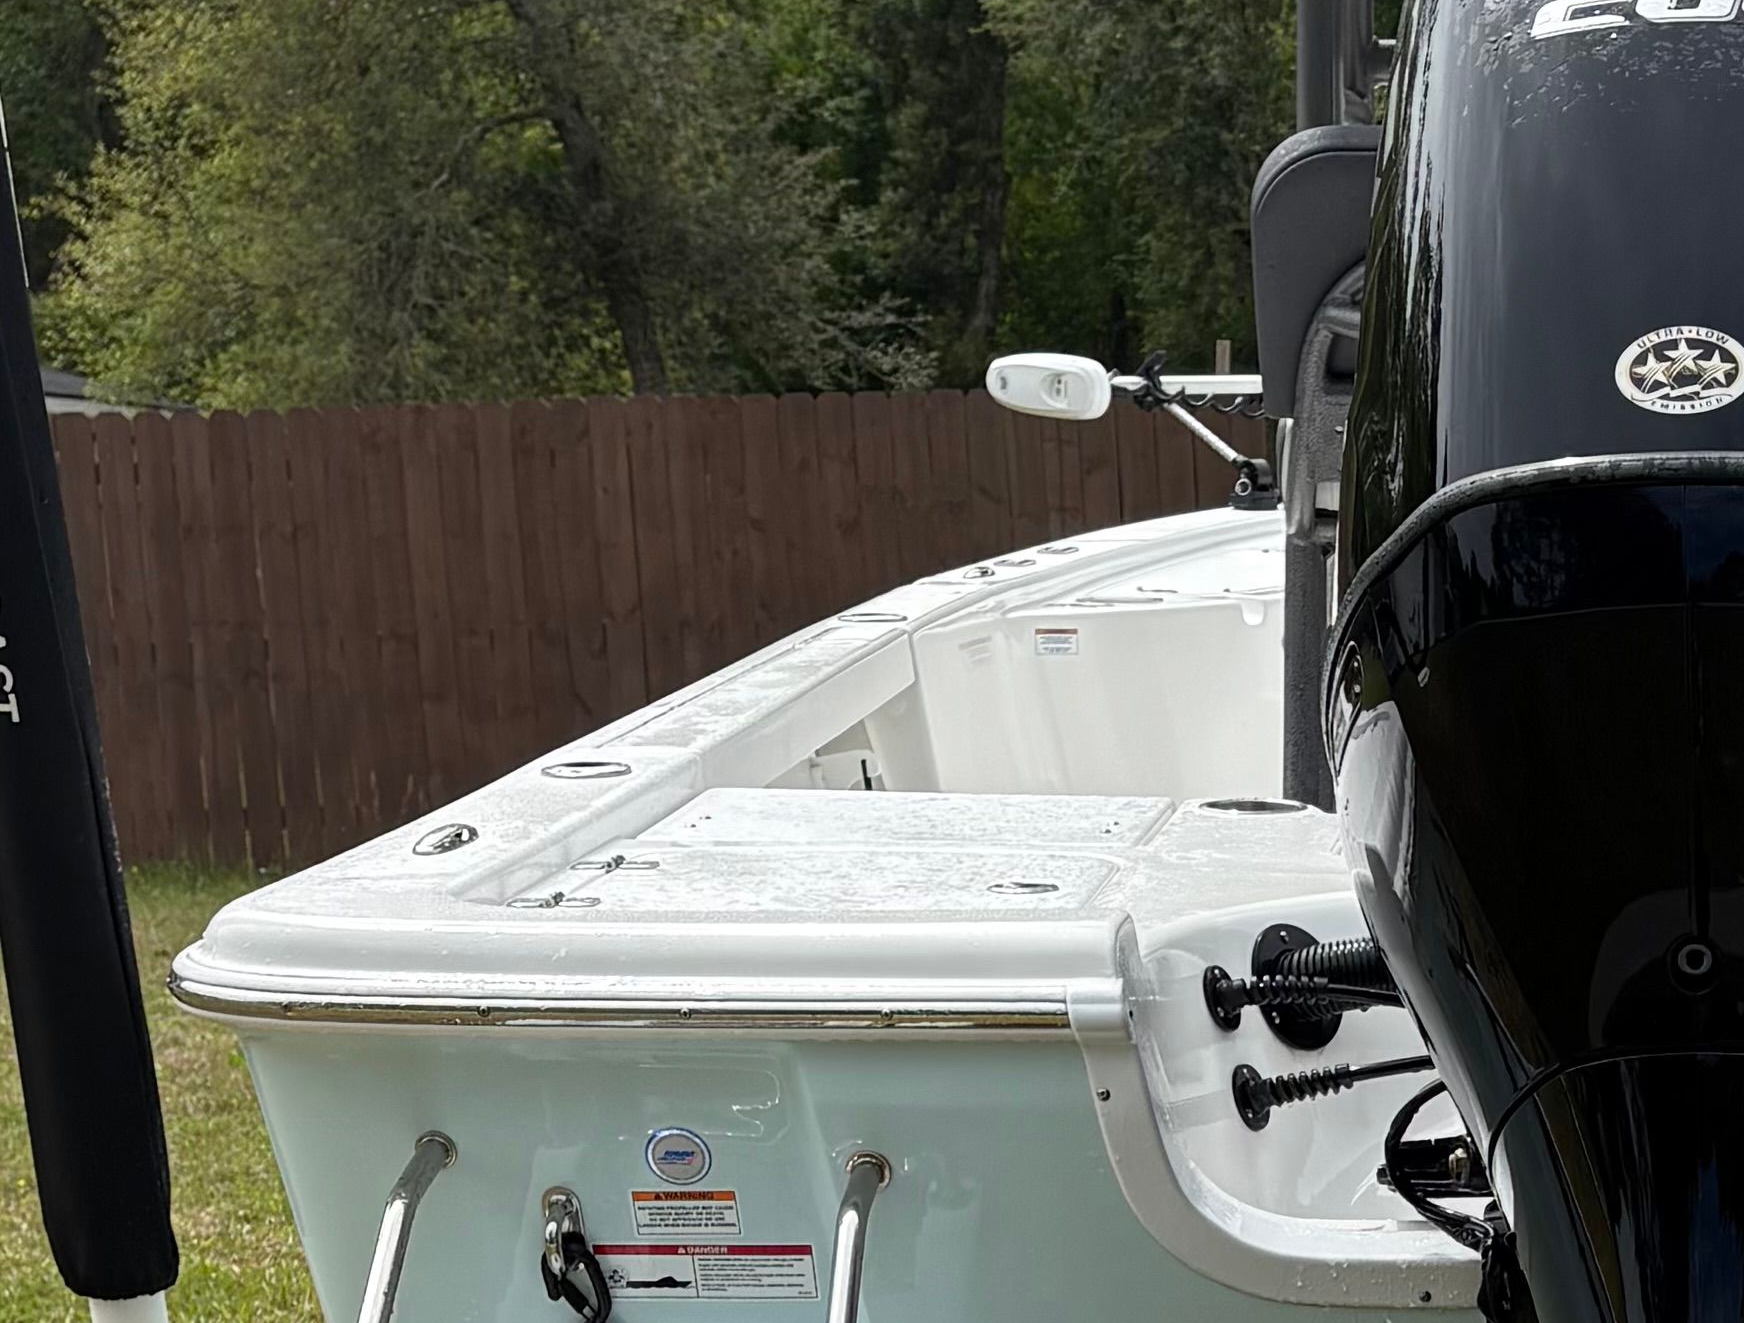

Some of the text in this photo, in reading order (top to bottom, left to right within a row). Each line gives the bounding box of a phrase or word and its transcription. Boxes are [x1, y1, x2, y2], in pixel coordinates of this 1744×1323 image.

[1636, 326, 1730, 351] ULTRA LOW
[661, 1191, 714, 1201] WARNING
[686, 1246, 728, 1255] DANGER
